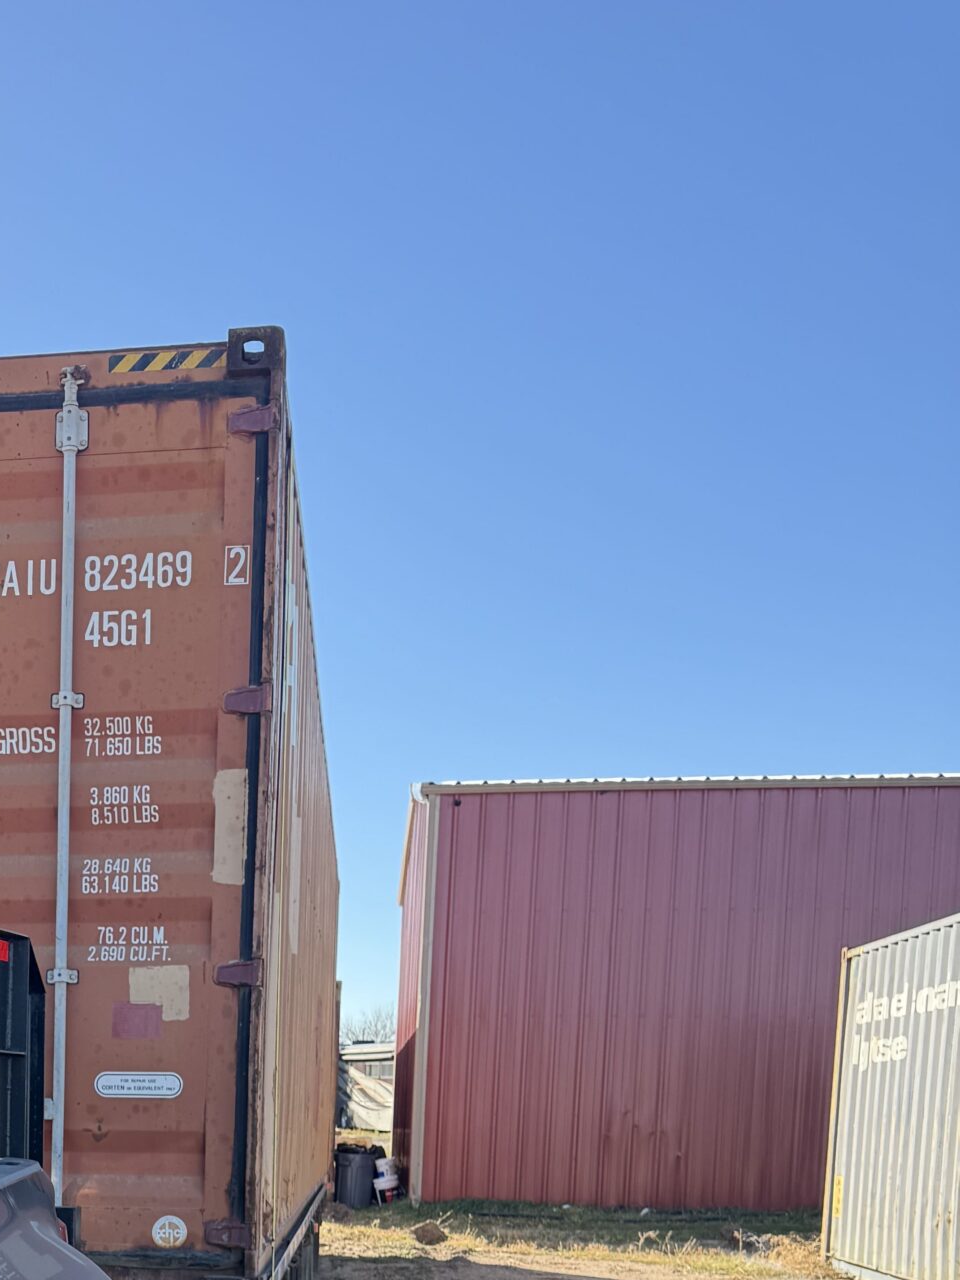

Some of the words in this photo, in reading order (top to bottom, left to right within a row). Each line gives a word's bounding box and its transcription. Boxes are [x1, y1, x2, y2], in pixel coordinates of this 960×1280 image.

[84, 550, 193, 592] 823469
[228, 547, 248, 584] 2
[84, 608, 152, 648] 45G1
[84, 717, 131, 736] 32.500
[136, 716, 153, 735] KG
[85, 737, 131, 757] 71.650
[136, 735, 162, 755] LBS
[90, 786, 129, 805] 3.860
[133, 785, 151, 804] KG
[91, 805, 129, 825] 8.510
[133, 803, 160, 823] LBS
[82, 858, 130, 875] 28.640
[133, 857, 151, 873] KG
[81, 876, 129, 894] 63.140
[133, 874, 159, 893] LBS
[97, 926, 127, 945] 76.2
[131, 926, 168, 945] CU.M.
[87, 946, 126, 962] 2.690
[129, 945, 171, 962] CU.FT.
